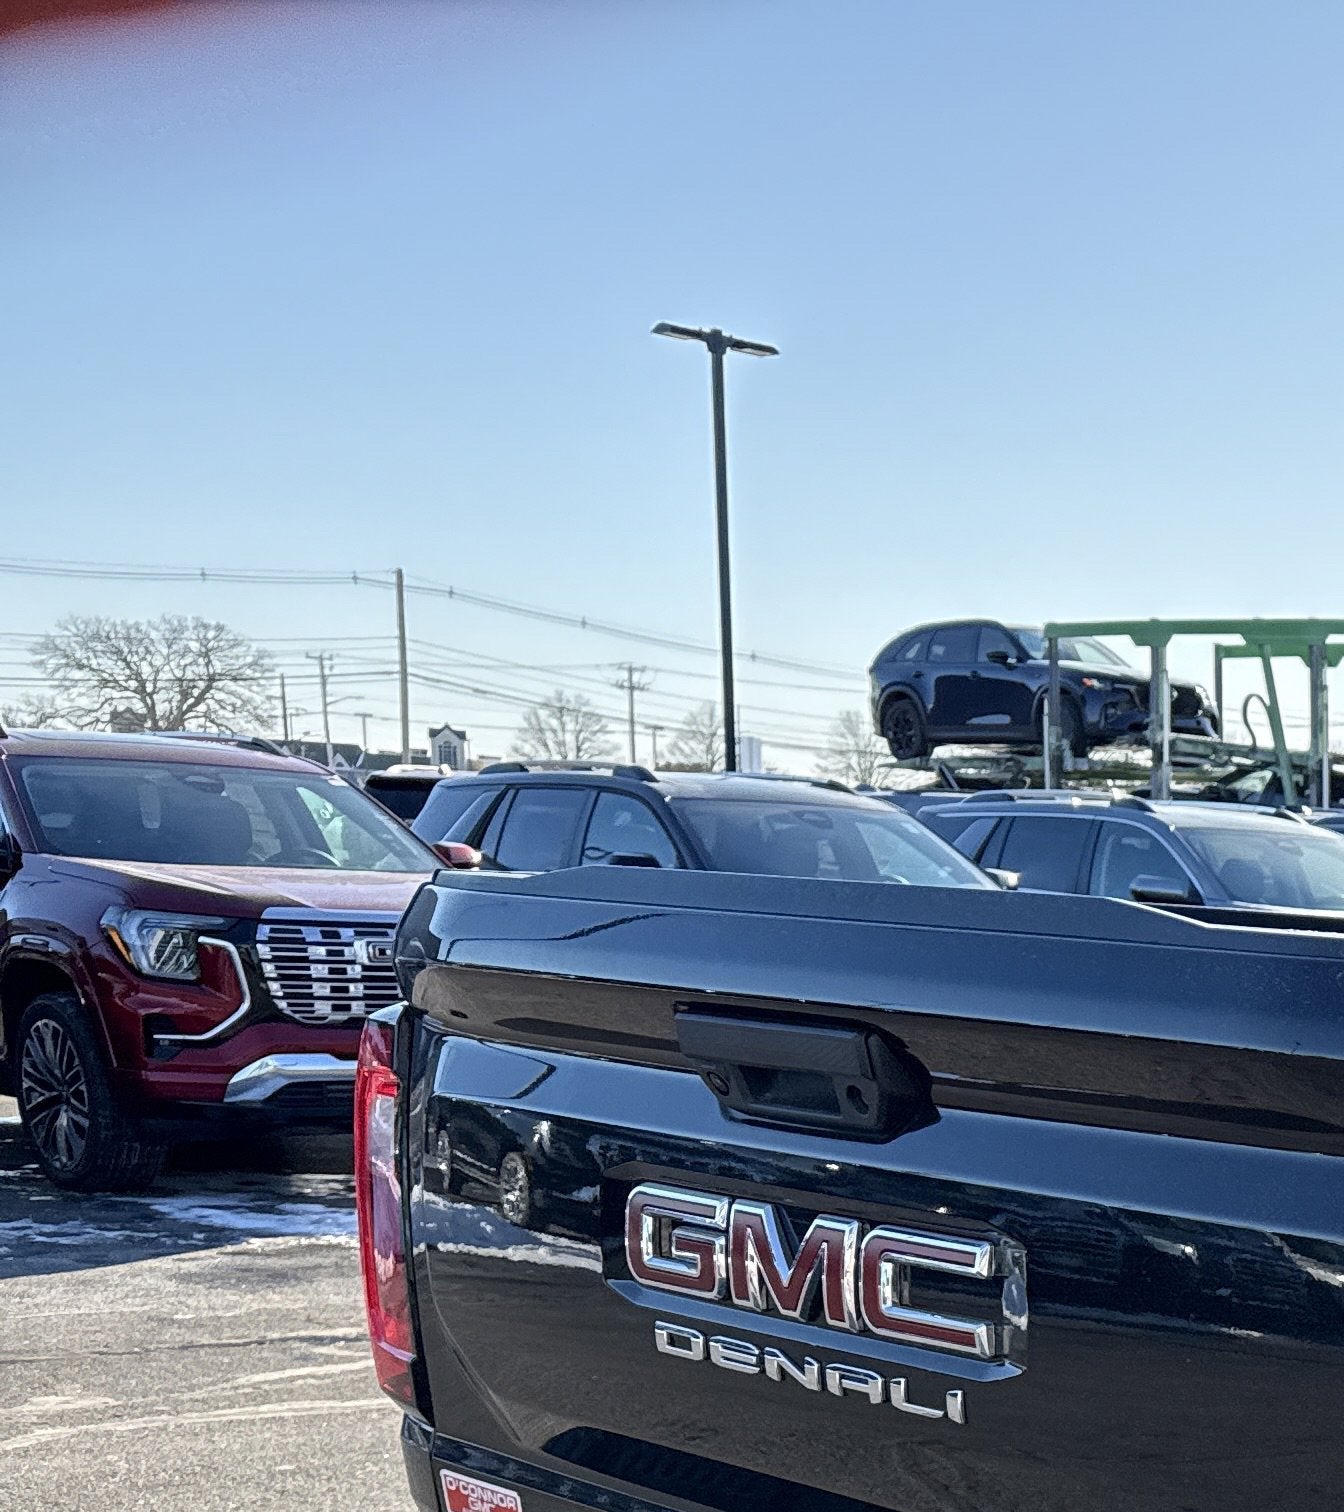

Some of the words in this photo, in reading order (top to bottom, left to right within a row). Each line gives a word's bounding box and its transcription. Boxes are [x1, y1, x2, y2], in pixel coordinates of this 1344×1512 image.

[624, 1181, 998, 1359] GMC
[654, 1320, 967, 1424] DENALI
[445, 1476, 517, 1512] O'CONNOR
